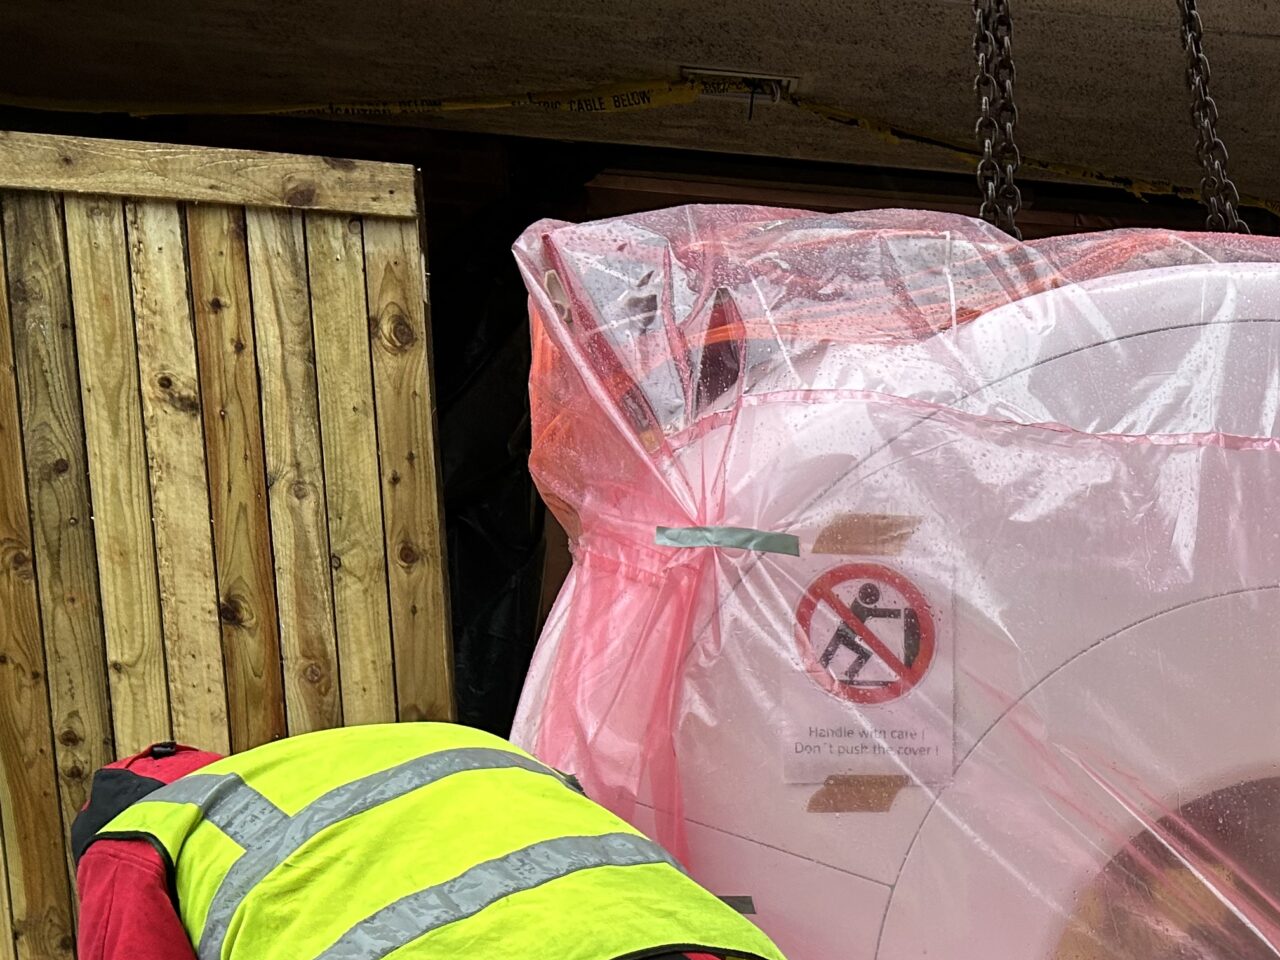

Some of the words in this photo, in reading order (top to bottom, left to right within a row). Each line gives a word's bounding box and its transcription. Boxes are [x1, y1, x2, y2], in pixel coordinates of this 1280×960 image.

[569, 97, 606, 111] CABLE
[612, 90, 651, 109] BELOW
[808, 726, 855, 739] Handle
[858, 728, 887, 740] with
[890, 729, 918, 740] care
[837, 743, 869, 756] push
[873, 744, 893, 755] the
[897, 745, 932, 756] cover
